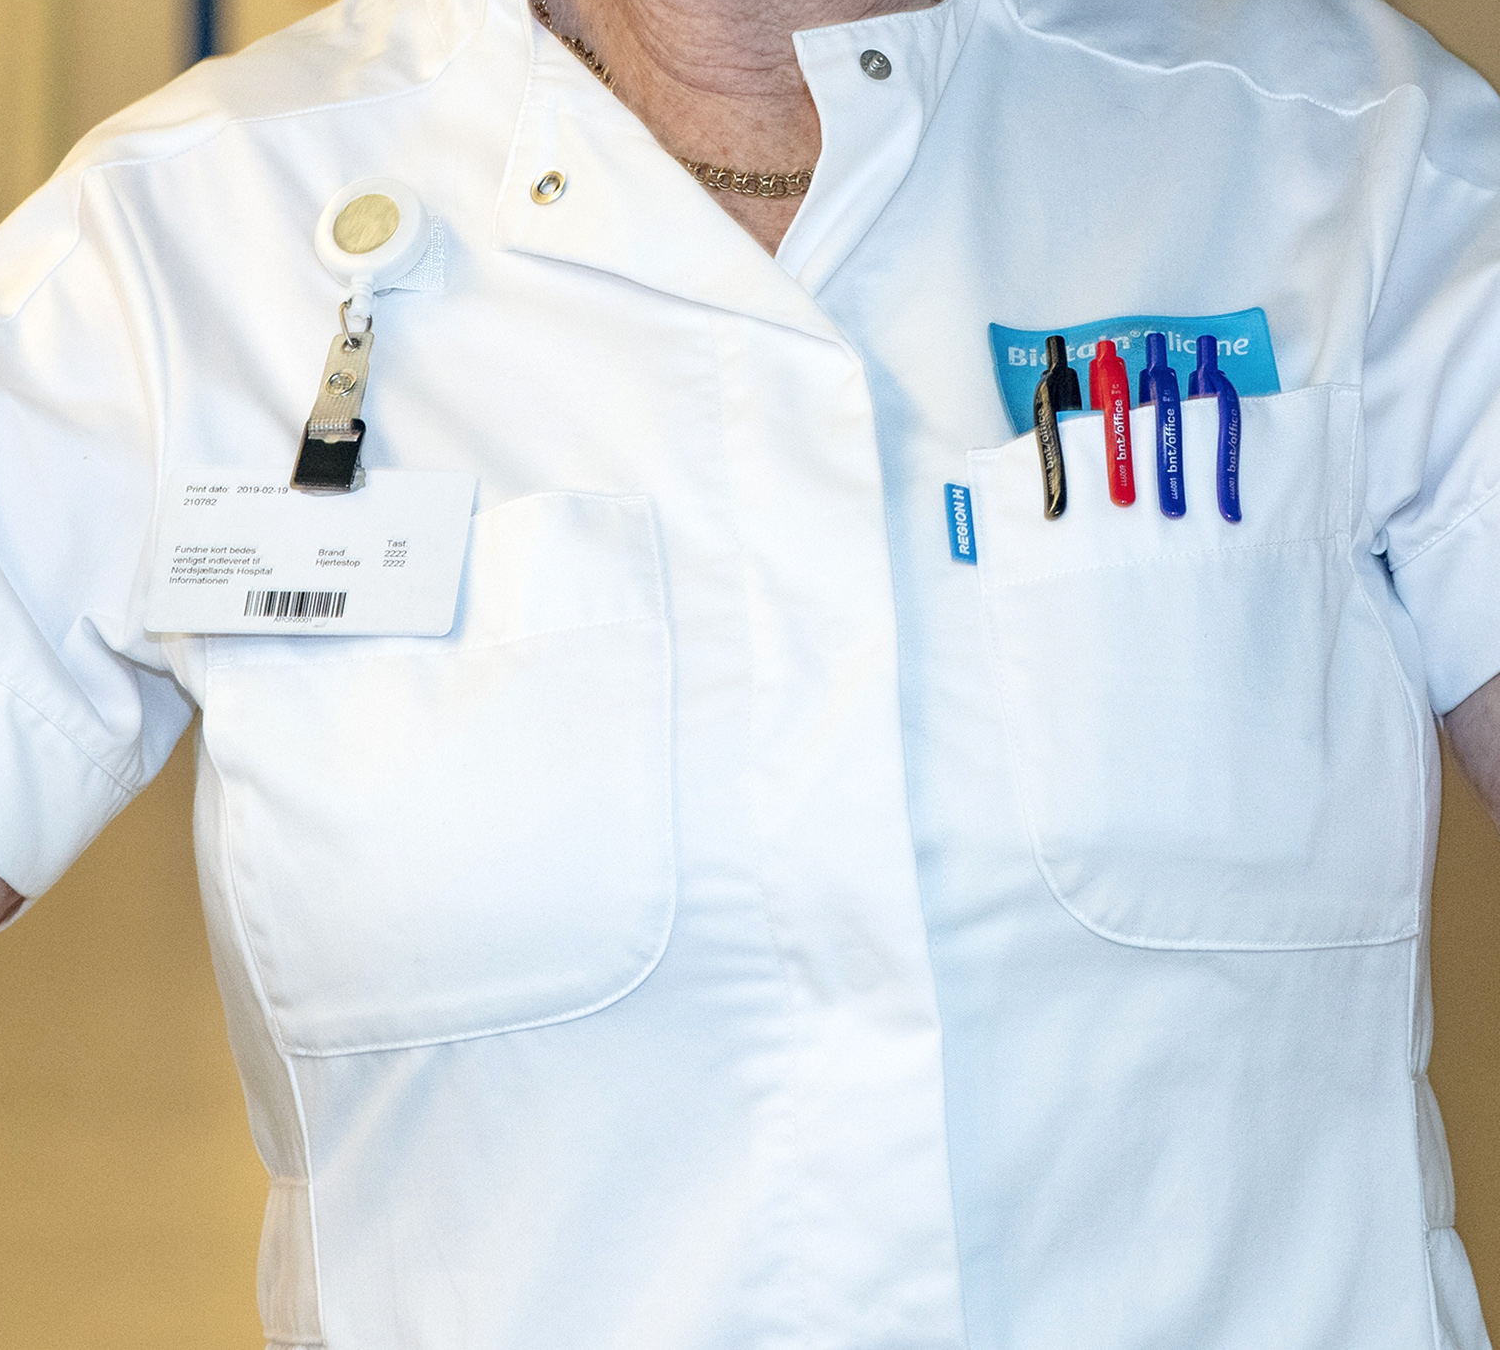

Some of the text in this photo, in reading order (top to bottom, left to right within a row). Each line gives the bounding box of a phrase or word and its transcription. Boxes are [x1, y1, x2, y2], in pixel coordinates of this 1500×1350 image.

[1113, 399, 1127, 461] bnt/office
[1165, 408, 1178, 473] bnt/office
[185, 485, 207, 494] Print
[236, 486, 289, 494] 2019-02-19
[183, 498, 218, 506] 210782
[952, 488, 971, 556] REGION H
[174, 546, 209, 554] Fundne
[318, 549, 408, 558] Brand 2222
[172, 557, 206, 566] venligst
[208, 557, 250, 565] indleveret
[315, 559, 406, 568] Hjertestop 2222
[171, 566, 273, 576] Nordsjællands Hospital
[169, 576, 229, 585] Informationen
